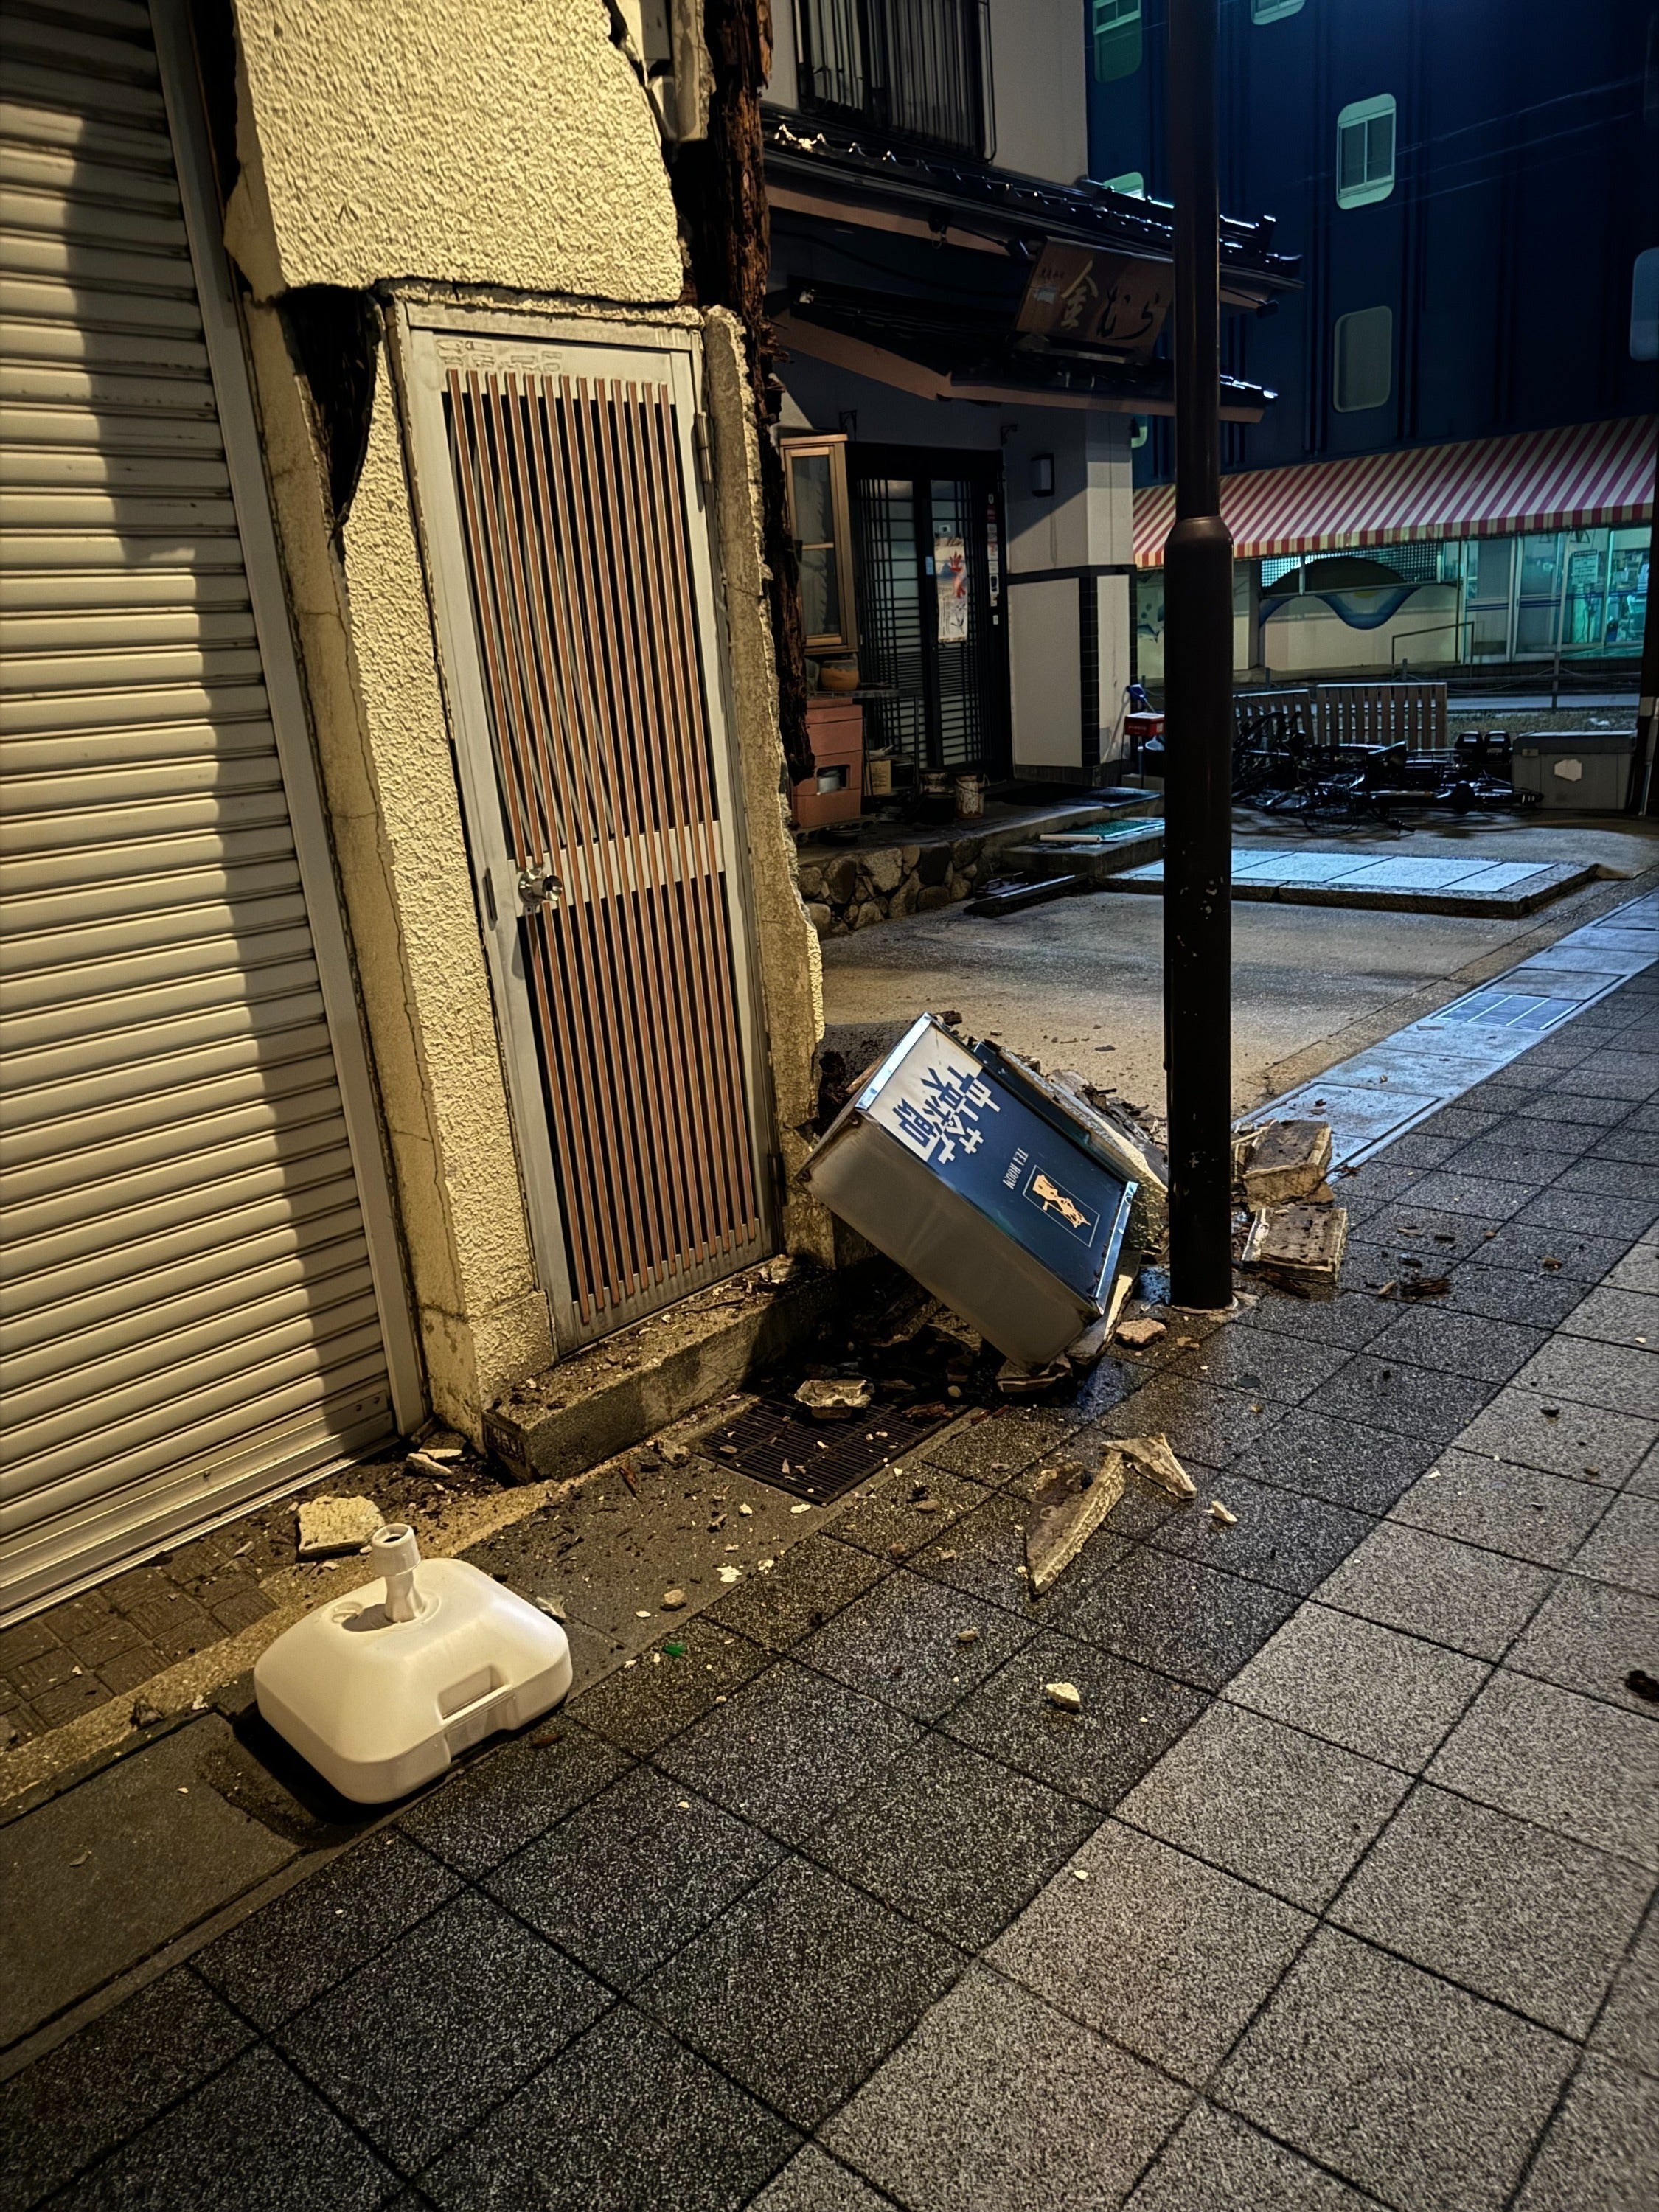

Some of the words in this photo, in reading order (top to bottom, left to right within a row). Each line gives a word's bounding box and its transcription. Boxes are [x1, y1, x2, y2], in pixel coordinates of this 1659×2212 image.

[892, 1065, 1001, 1164] 中央茶廊
[1012, 1147, 1029, 1166] TEA
[1003, 1162, 1021, 1189] ROOM
